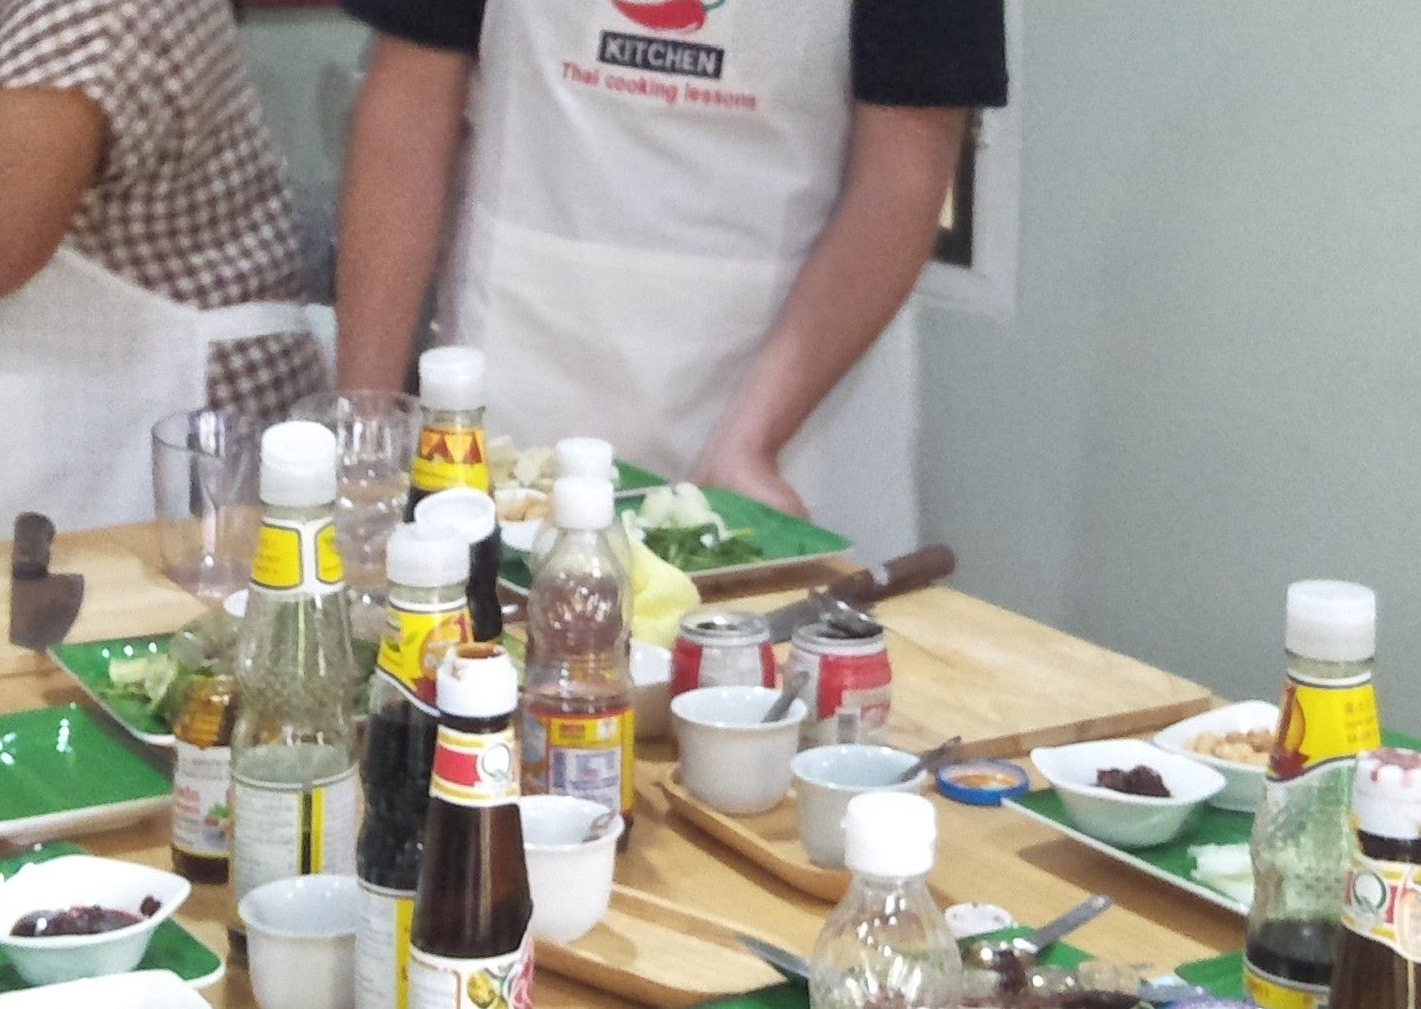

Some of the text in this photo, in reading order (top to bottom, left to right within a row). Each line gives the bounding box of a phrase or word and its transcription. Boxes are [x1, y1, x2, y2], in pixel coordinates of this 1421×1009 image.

[603, 37, 717, 75] KITCHEN
[563, 62, 600, 86] Thai
[604, 74, 678, 105] cooking
